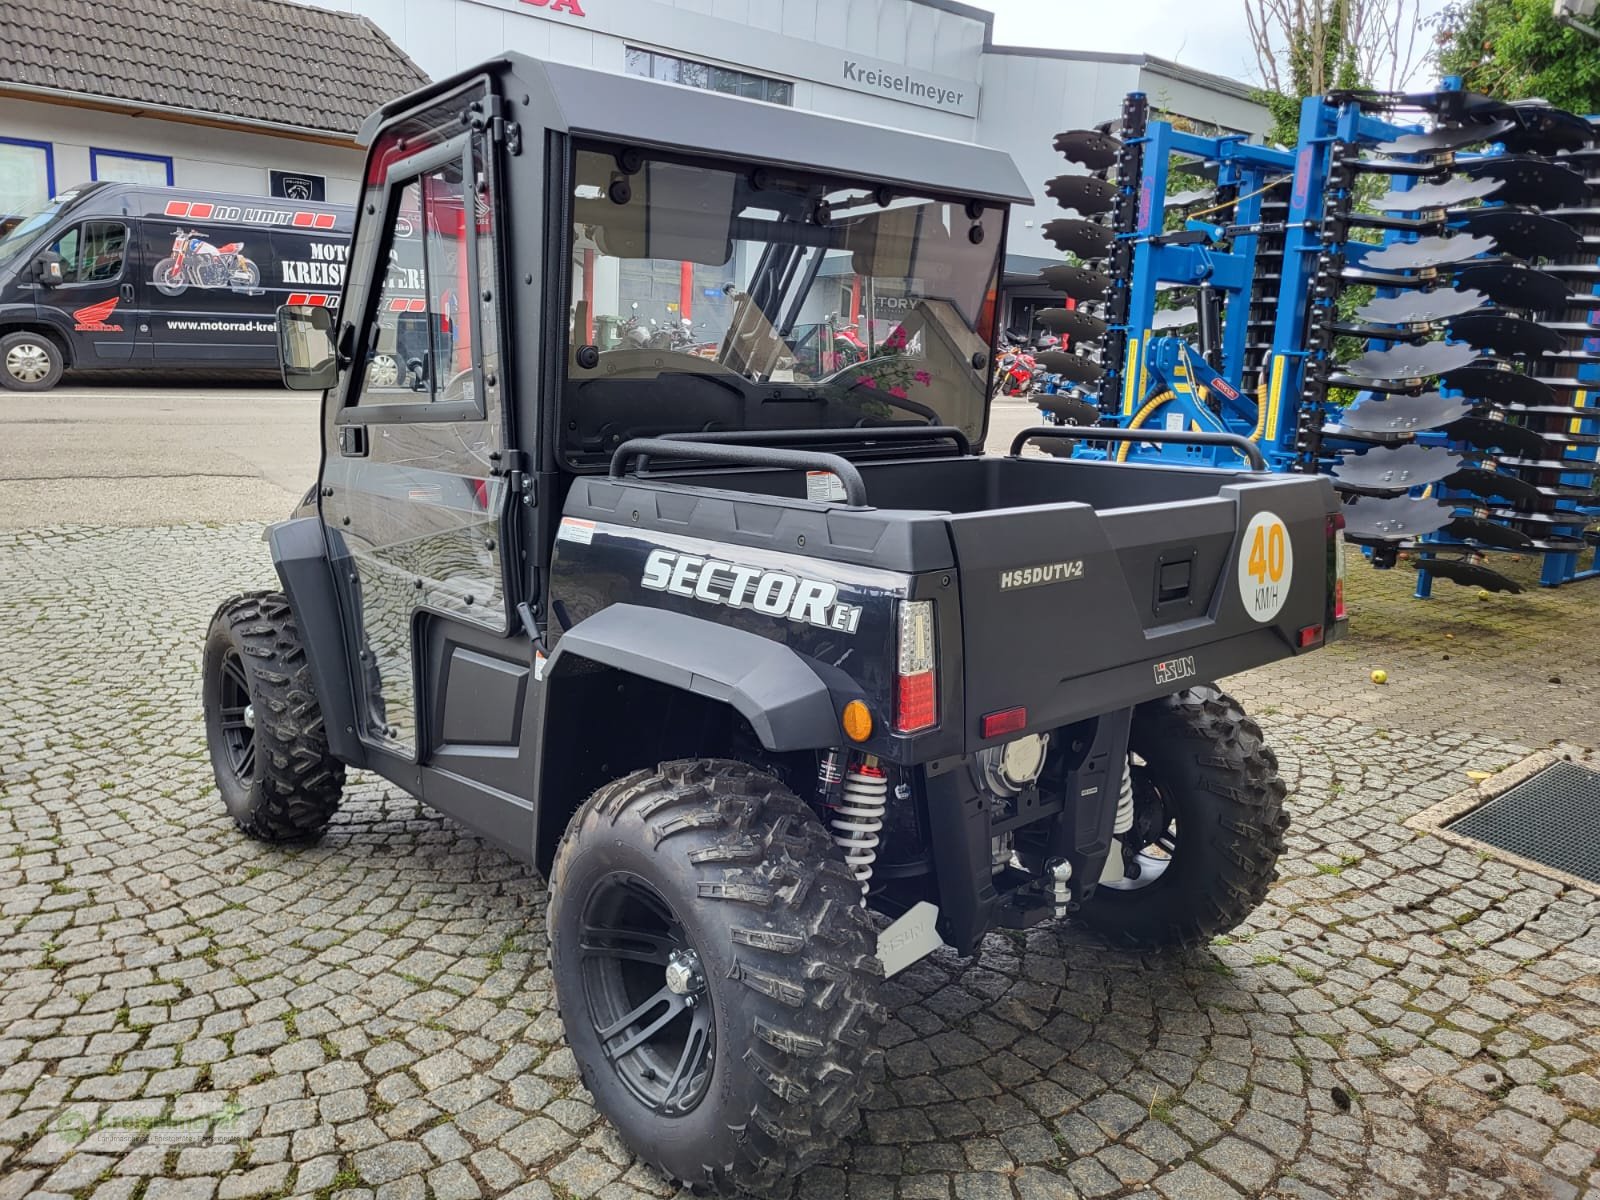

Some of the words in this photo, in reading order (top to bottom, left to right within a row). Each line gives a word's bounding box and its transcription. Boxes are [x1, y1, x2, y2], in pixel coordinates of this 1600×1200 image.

[843, 60, 964, 105] Kreiselmeyer
[1248, 523, 1285, 584] 40
[641, 549, 837, 627] SECTOR
[831, 603, 862, 634] E1
[1000, 560, 1083, 589] HS5DUTV-2
[1255, 585, 1279, 612] KM/H
[1153, 655, 1196, 685] HSUN
